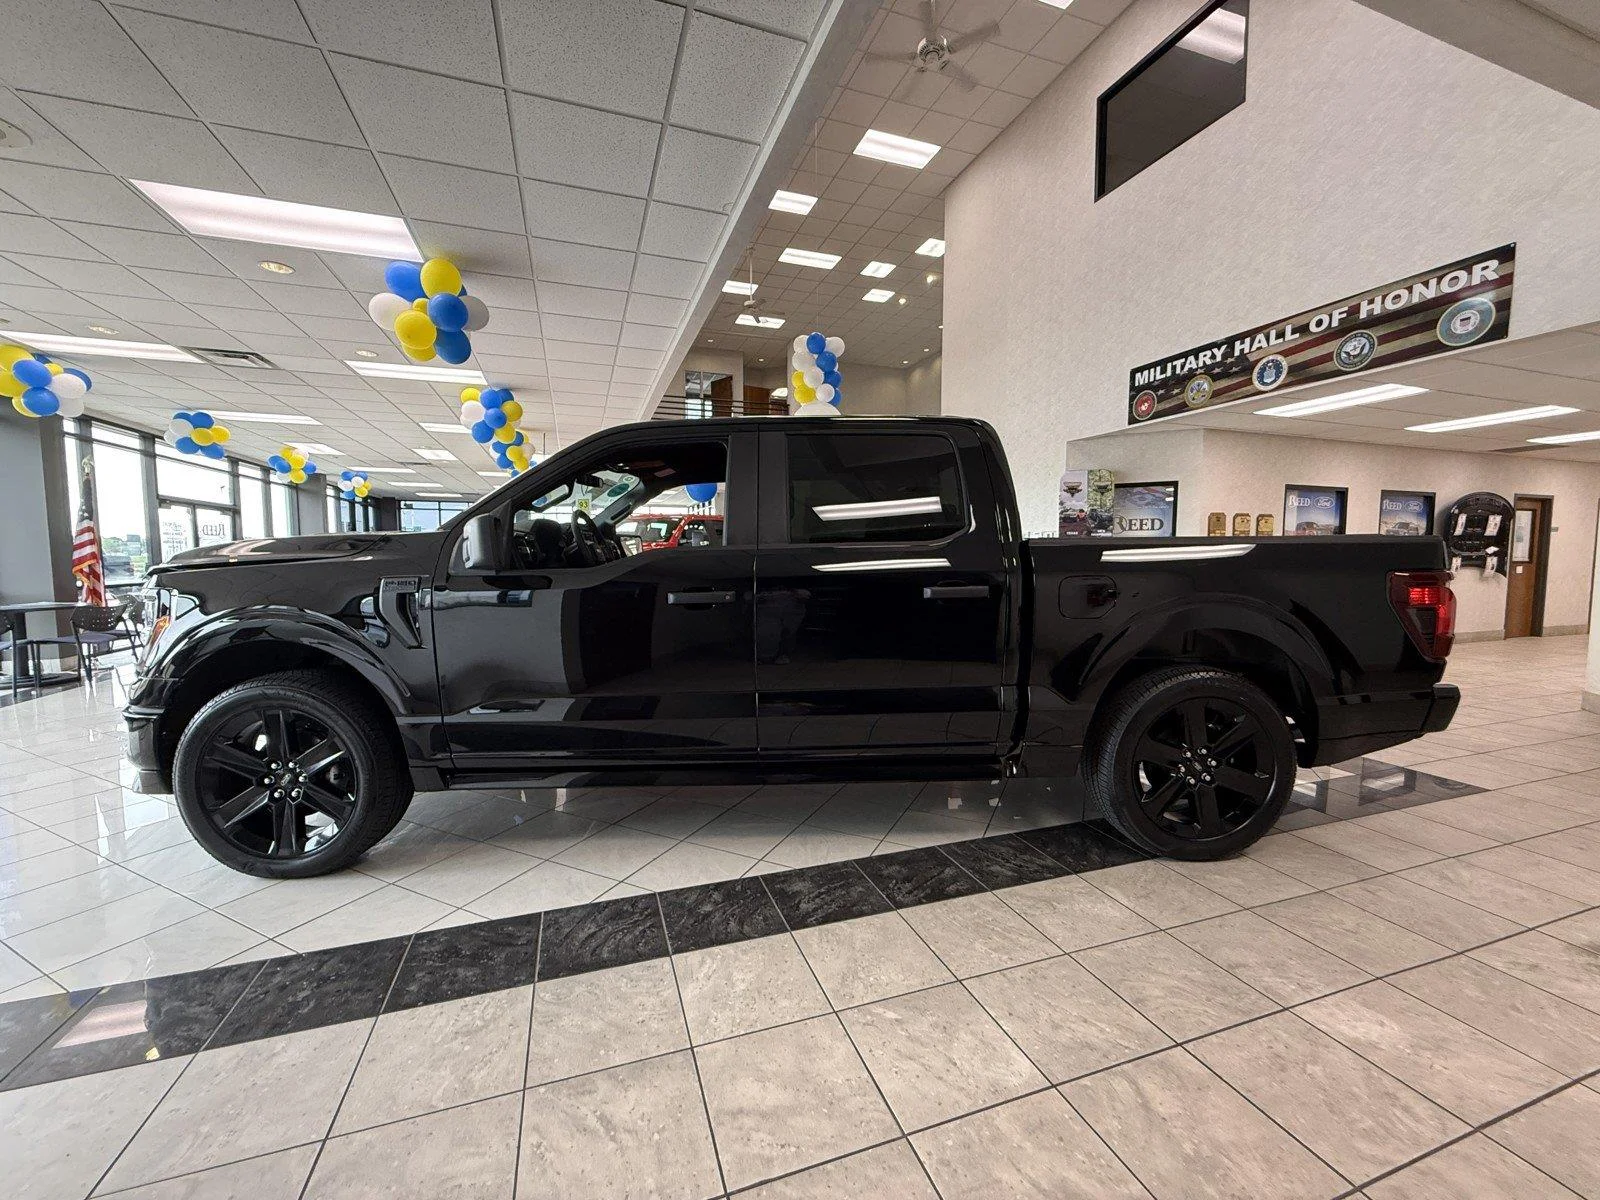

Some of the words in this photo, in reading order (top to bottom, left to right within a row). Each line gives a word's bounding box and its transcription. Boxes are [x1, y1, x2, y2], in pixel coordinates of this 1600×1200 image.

[1134, 345, 1228, 387] MILITARY
[1233, 325, 1300, 357] HALL
[1308, 306, 1349, 333] OF
[1359, 259, 1500, 319] HONOR
[1289, 495, 1310, 508] REED
[1316, 498, 1333, 508] Ford
[1383, 500, 1402, 511] REED
[1113, 514, 1164, 534] REED
